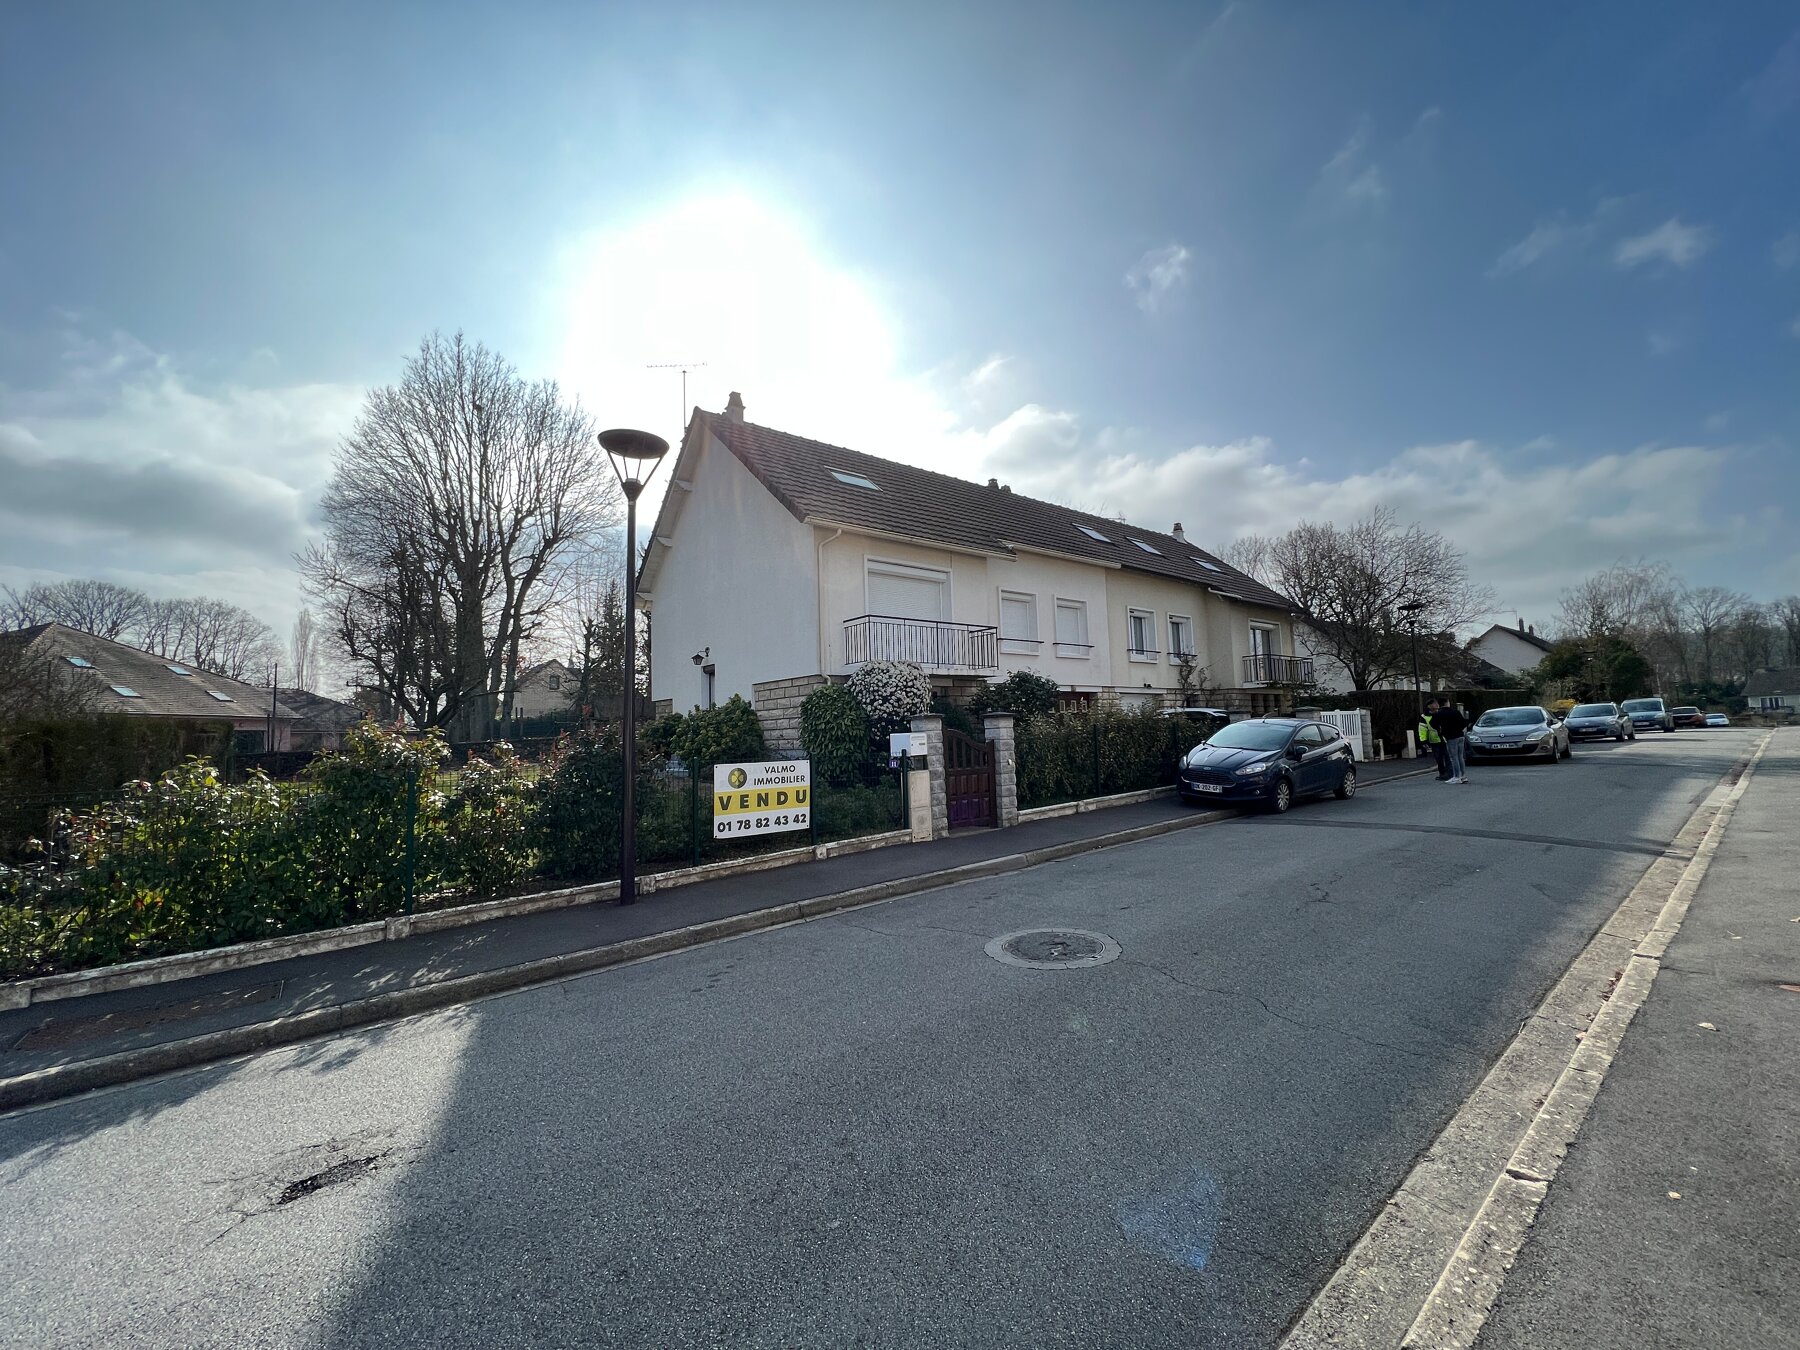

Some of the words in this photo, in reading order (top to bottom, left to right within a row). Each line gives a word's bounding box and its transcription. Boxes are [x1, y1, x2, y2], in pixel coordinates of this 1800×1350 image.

[764, 765, 796, 774] VALMO
[754, 775, 805, 786] IMMOBILIER
[718, 789, 807, 811] VENDU
[717, 821, 732, 833] 01
[737, 819, 751, 831] 78
[756, 817, 770, 829] 82
[774, 815, 789, 826] 43
[793, 813, 807, 824] 42
